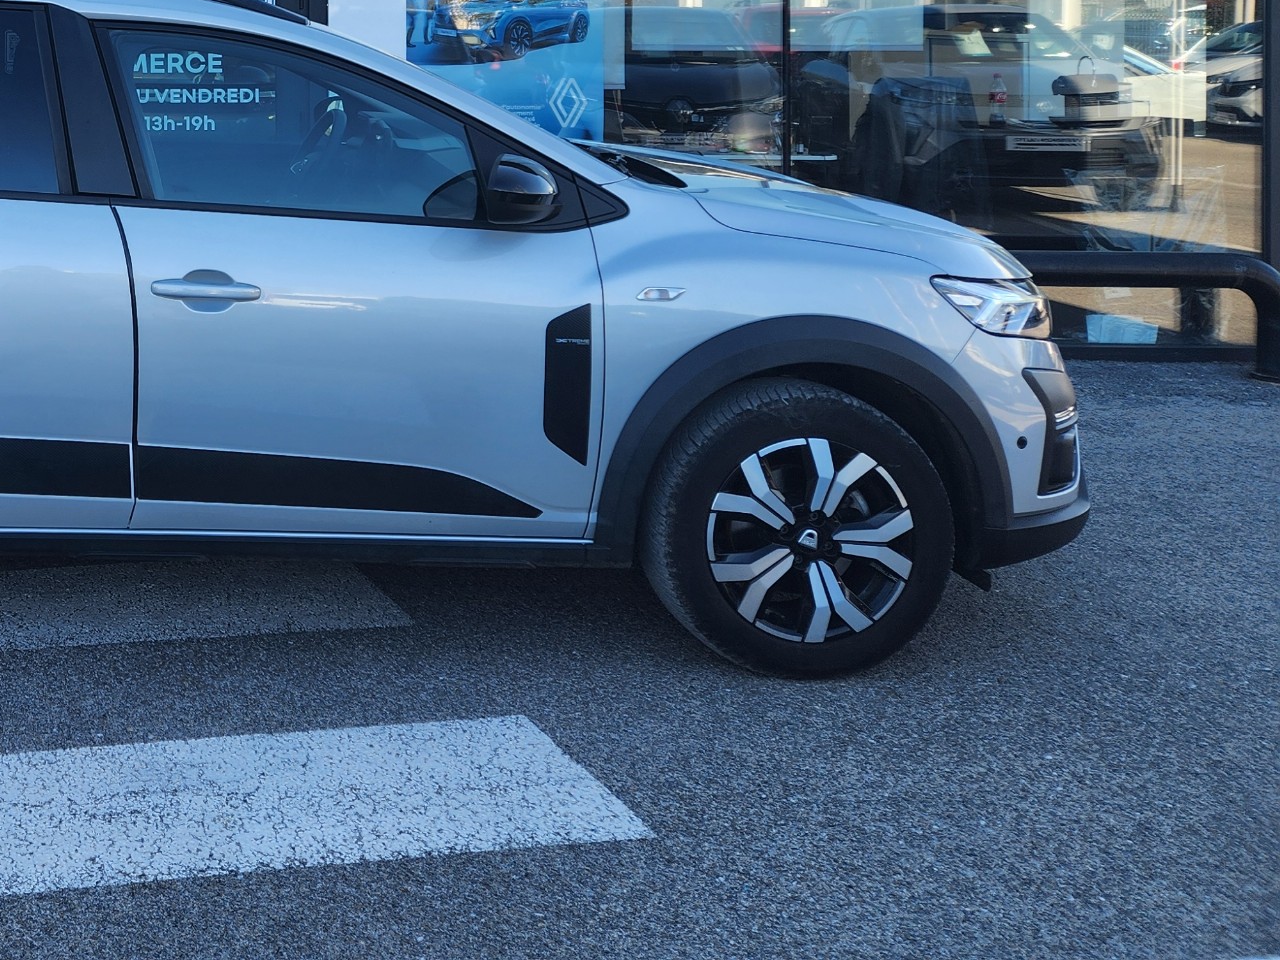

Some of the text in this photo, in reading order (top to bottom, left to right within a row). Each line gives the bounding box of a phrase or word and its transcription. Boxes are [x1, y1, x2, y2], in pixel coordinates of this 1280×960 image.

[133, 53, 223, 74] MERCE
[154, 88, 260, 103] VENDREDI
[144, 115, 216, 131] 13h-19h
